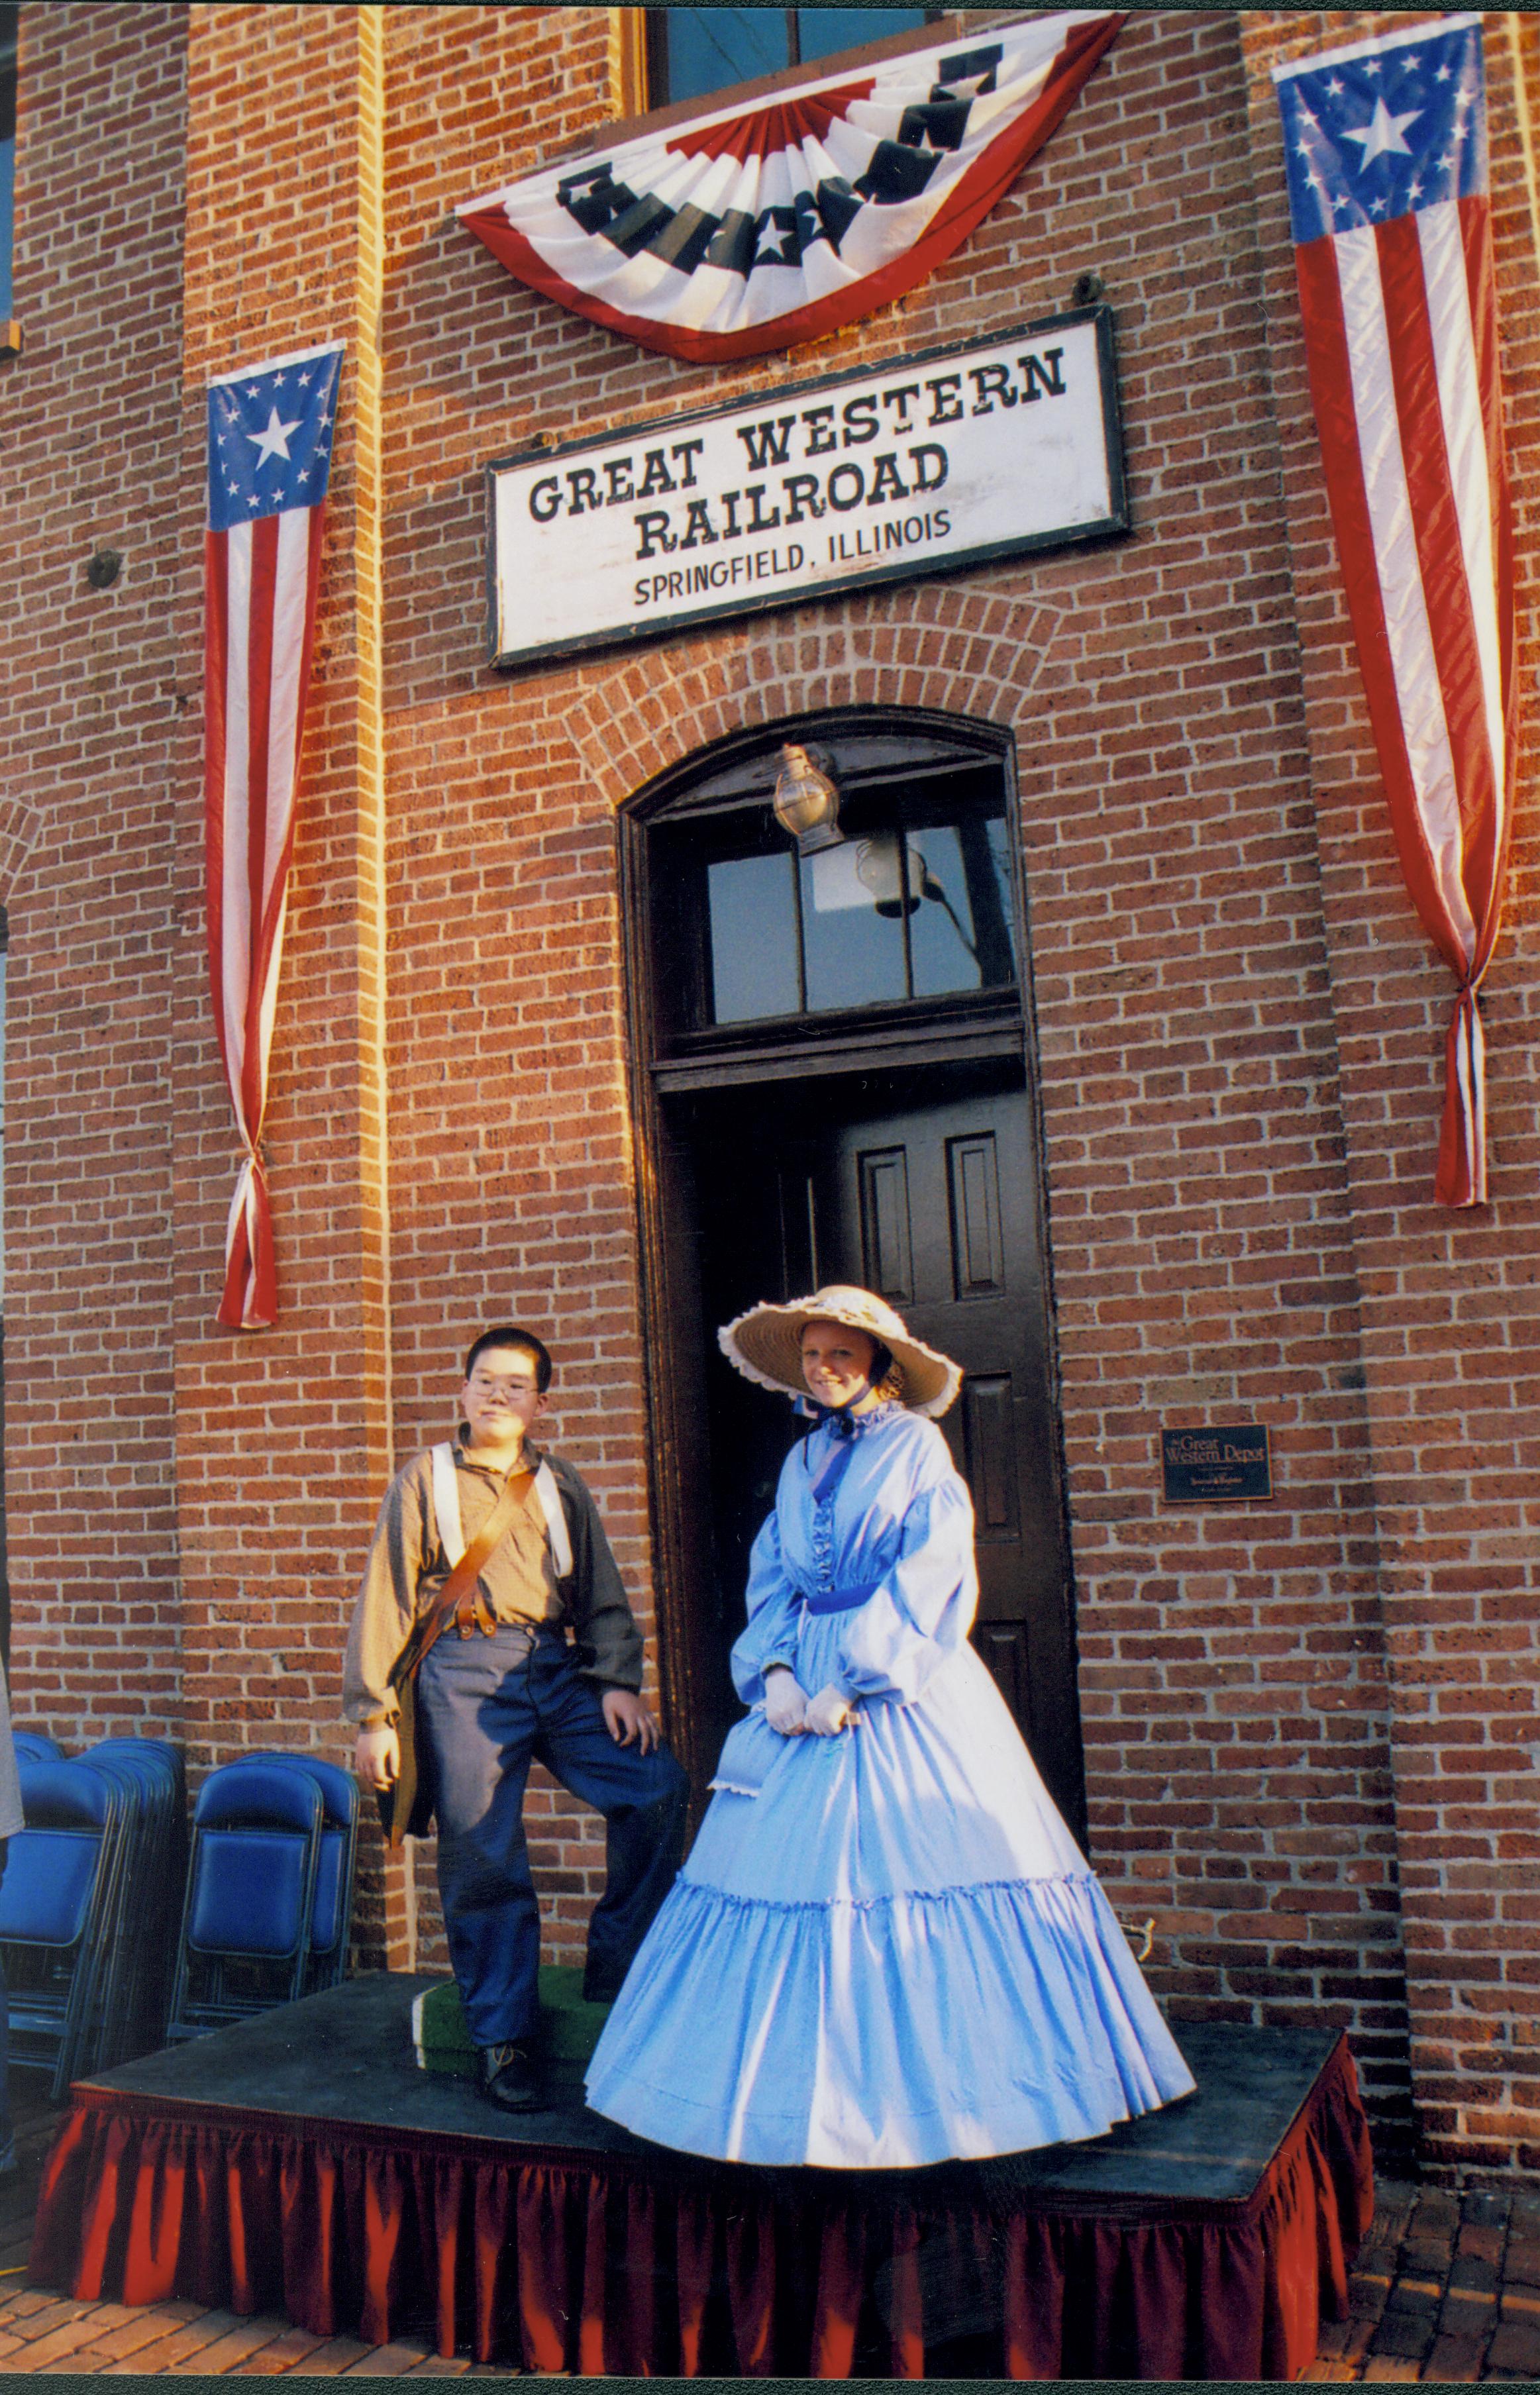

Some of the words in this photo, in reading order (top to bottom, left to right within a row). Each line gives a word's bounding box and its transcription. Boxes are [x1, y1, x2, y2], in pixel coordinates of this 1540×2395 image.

[529, 438, 703, 523] GREAT
[738, 348, 1066, 471] WESTERN
[634, 545, 815, 605] SPRINGFIELD,
[829, 509, 951, 562] ILLINOIS
[635, 443, 948, 560] RAILROAD
